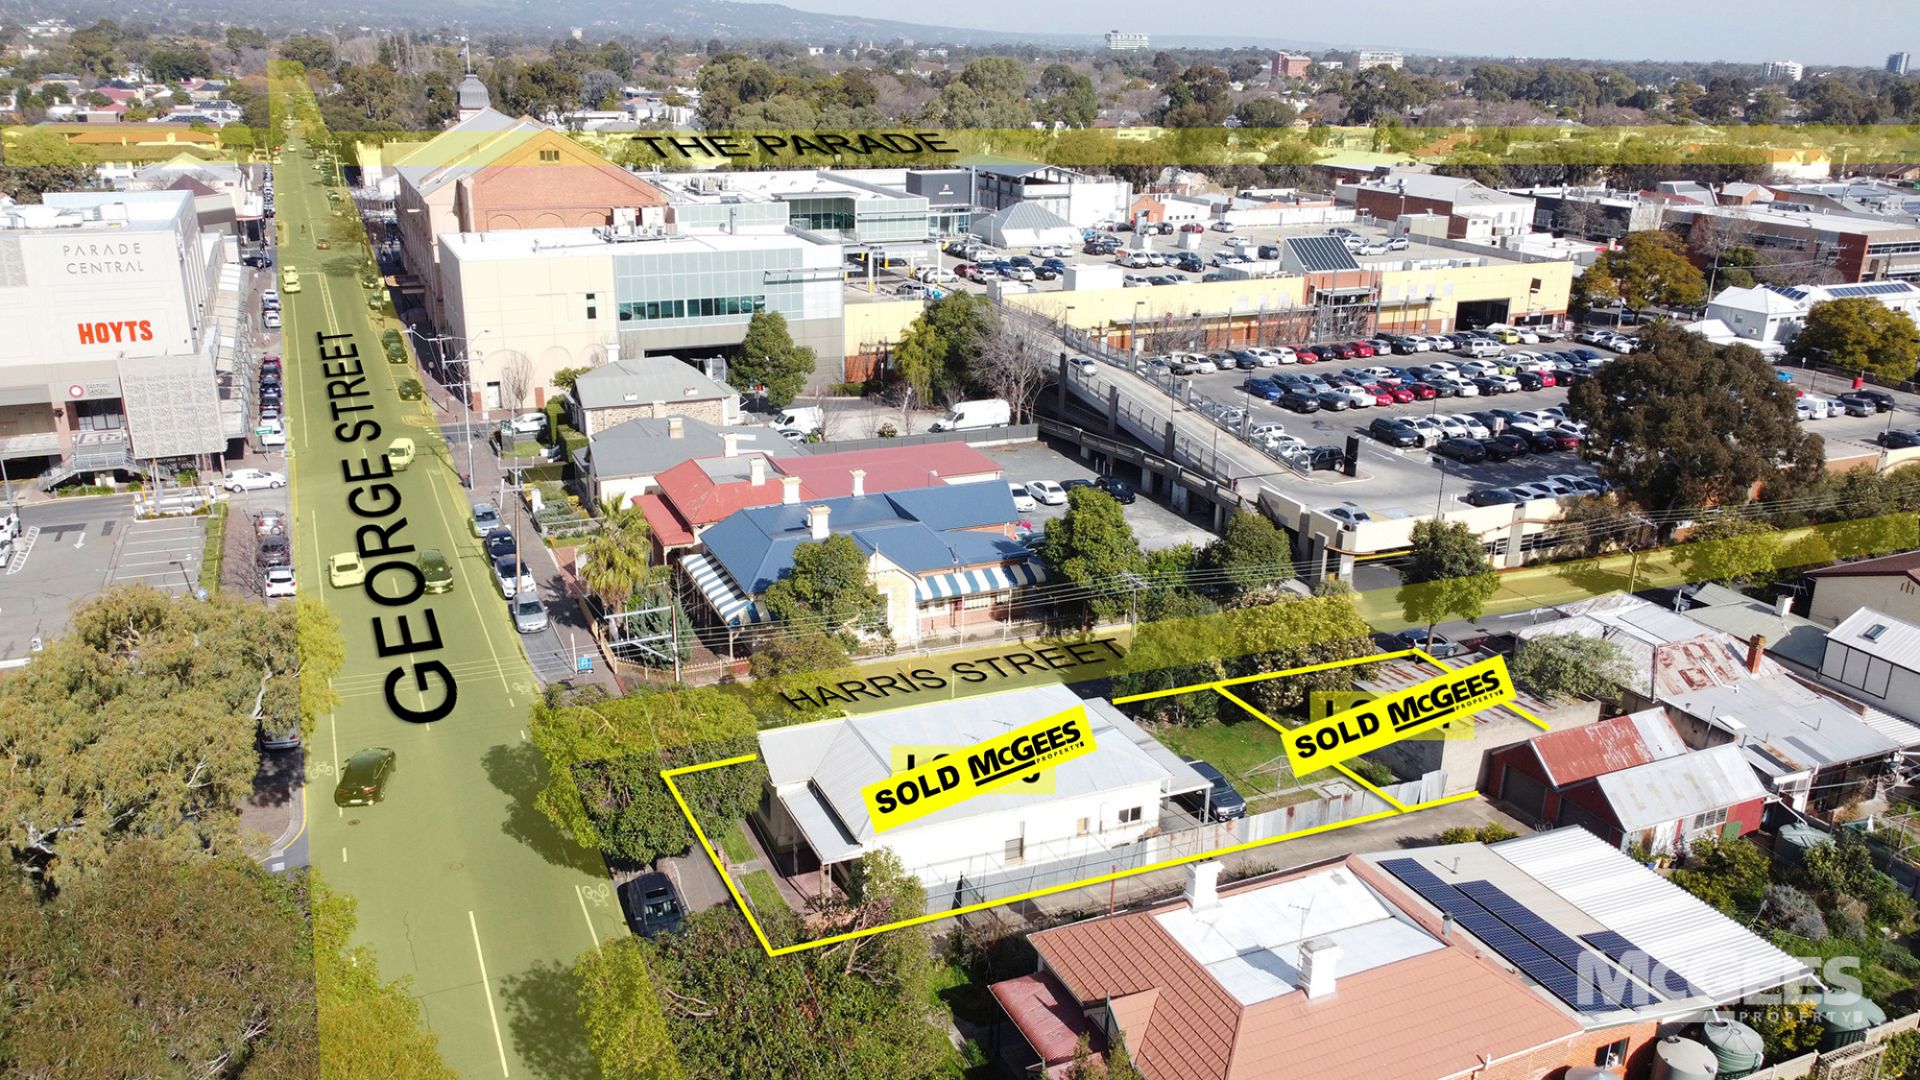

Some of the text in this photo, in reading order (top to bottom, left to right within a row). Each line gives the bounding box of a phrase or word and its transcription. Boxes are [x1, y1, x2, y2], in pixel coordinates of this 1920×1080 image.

[63, 242, 141, 257] PARADE
[66, 261, 144, 275] CENTRAL
[77, 319, 153, 345] HOYTS
